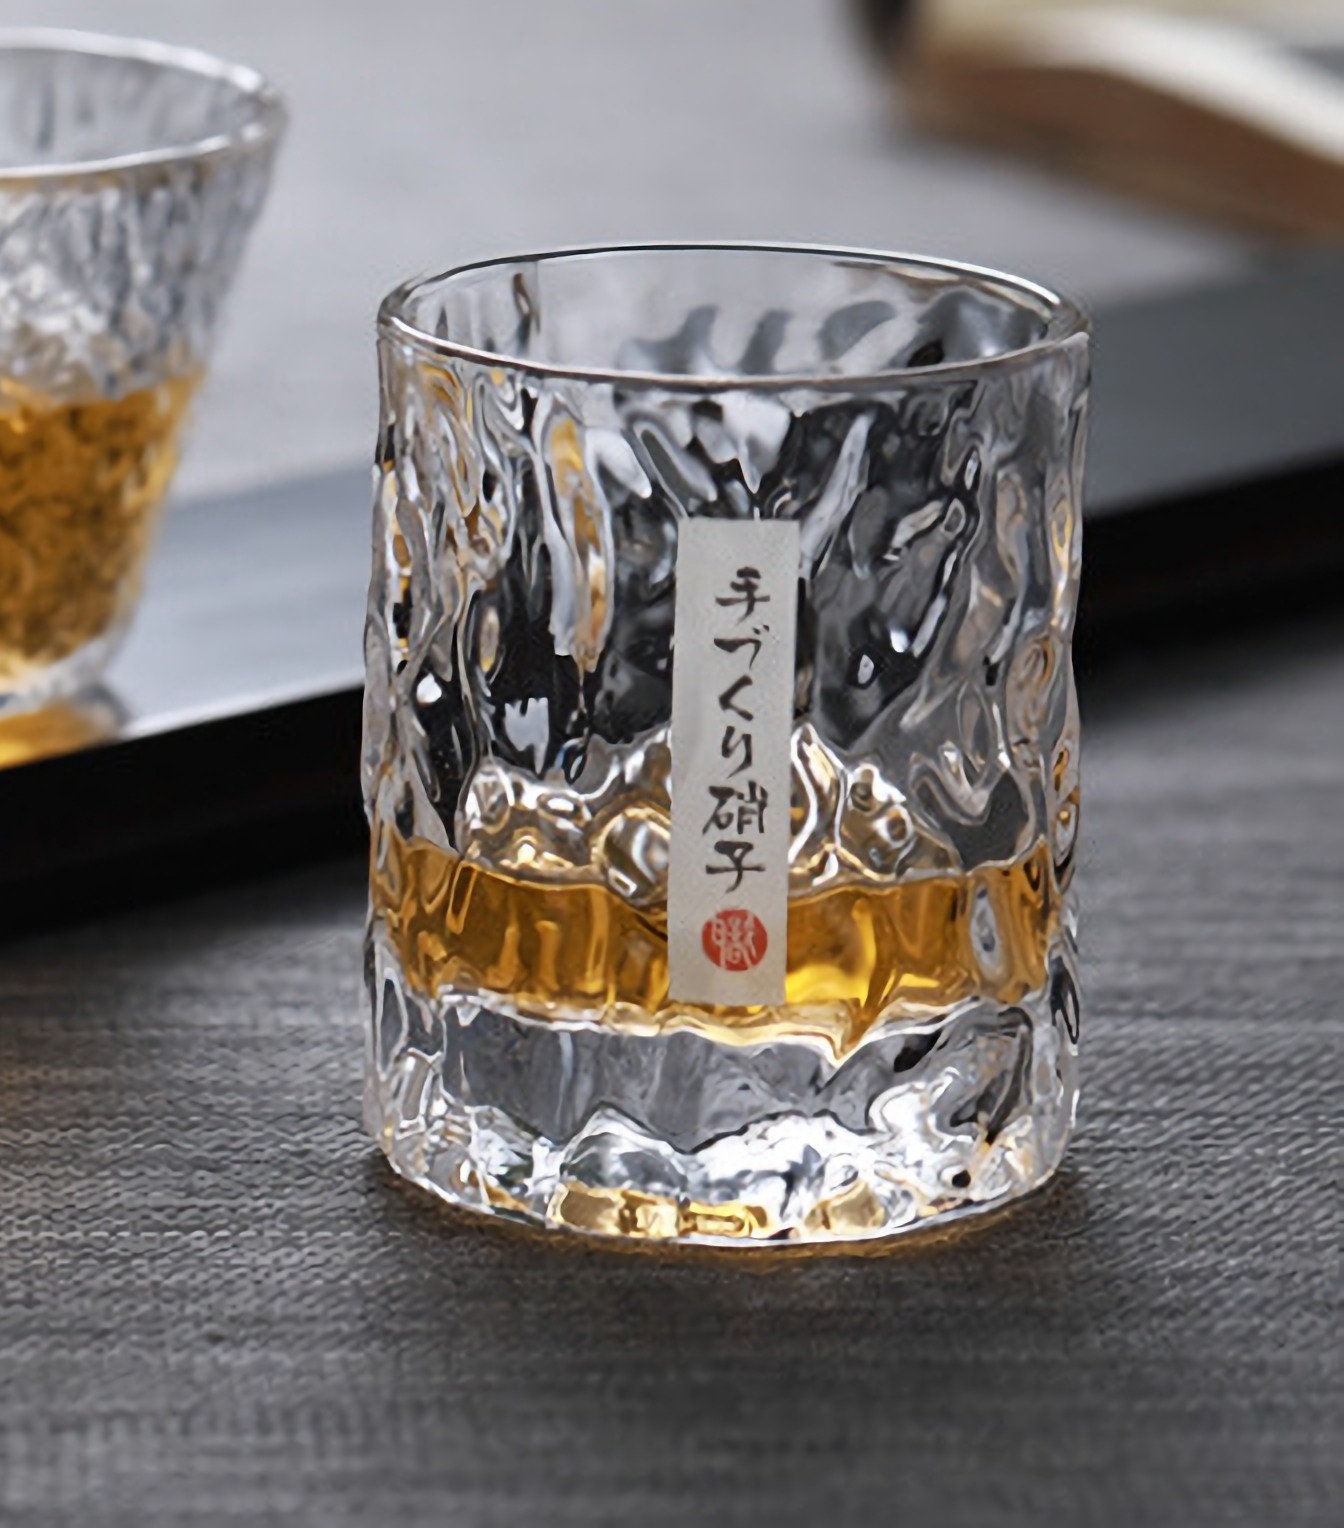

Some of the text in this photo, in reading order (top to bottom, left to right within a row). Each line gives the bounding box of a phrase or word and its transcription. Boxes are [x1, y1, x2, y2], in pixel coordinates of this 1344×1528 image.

[702, 566, 770, 893] 手づくり硝子
